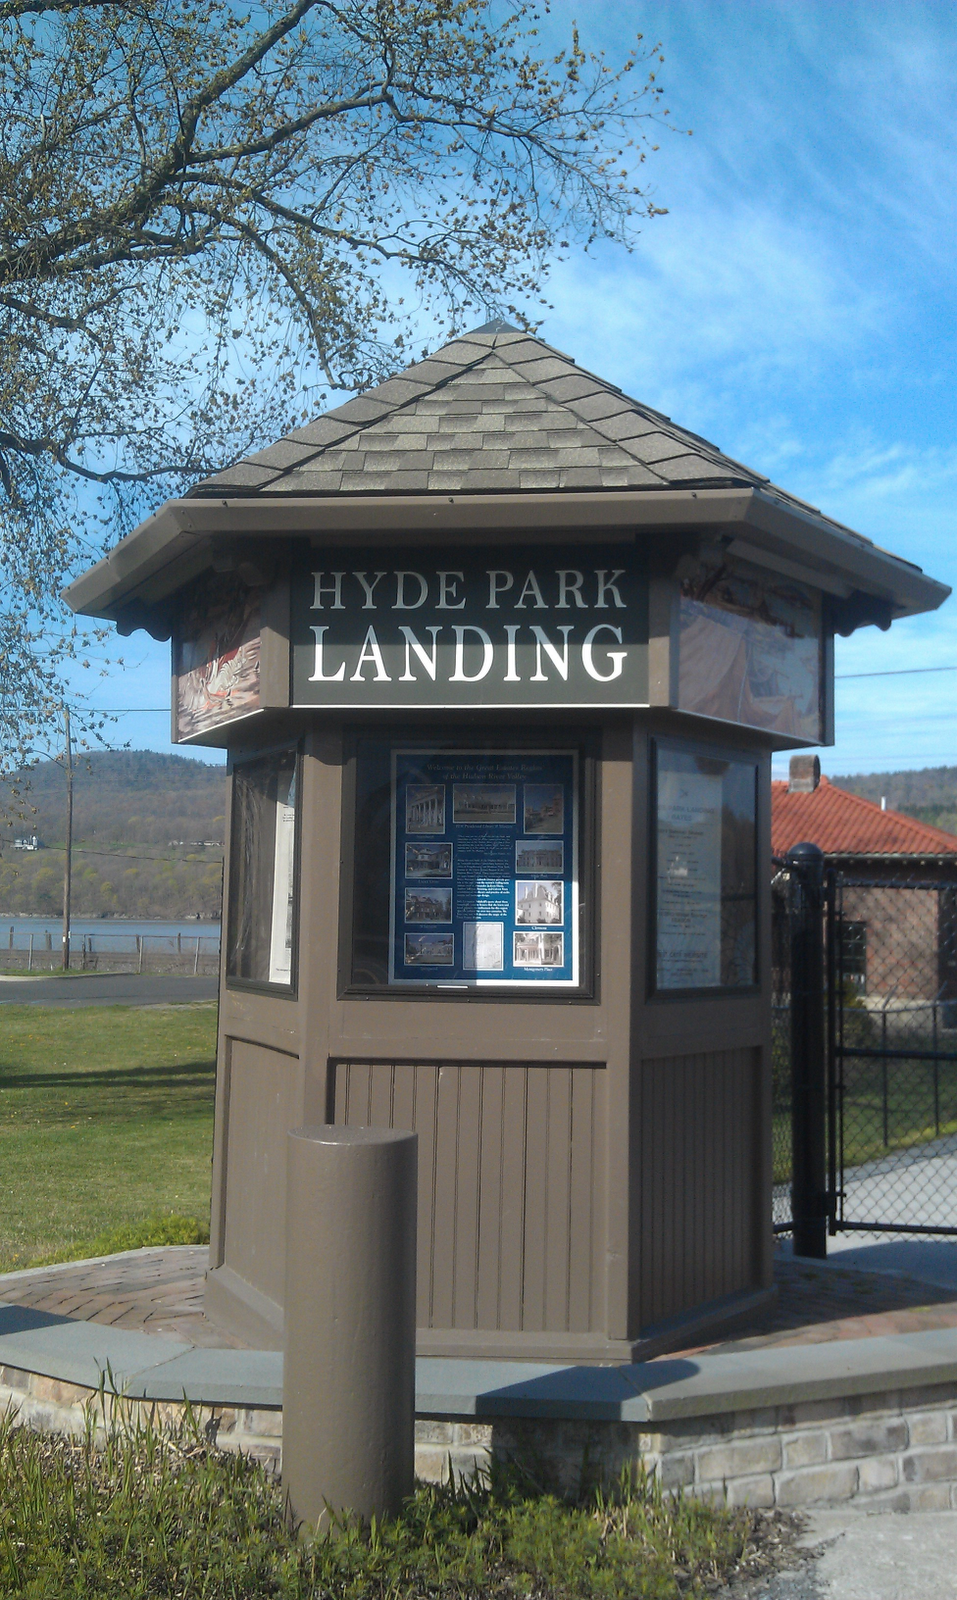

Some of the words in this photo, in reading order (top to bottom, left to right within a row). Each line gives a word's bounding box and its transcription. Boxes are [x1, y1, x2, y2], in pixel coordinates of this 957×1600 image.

[309, 571, 467, 610] HYDE
[485, 570, 627, 609] PARK
[308, 623, 628, 683] LANDING
[427, 763, 455, 771] Welcome
[464, 763, 474, 771] the
[476, 763, 494, 772] Great
[450, 772, 460, 780] the
[462, 772, 487, 780] Hudson
[488, 772, 505, 780] River
